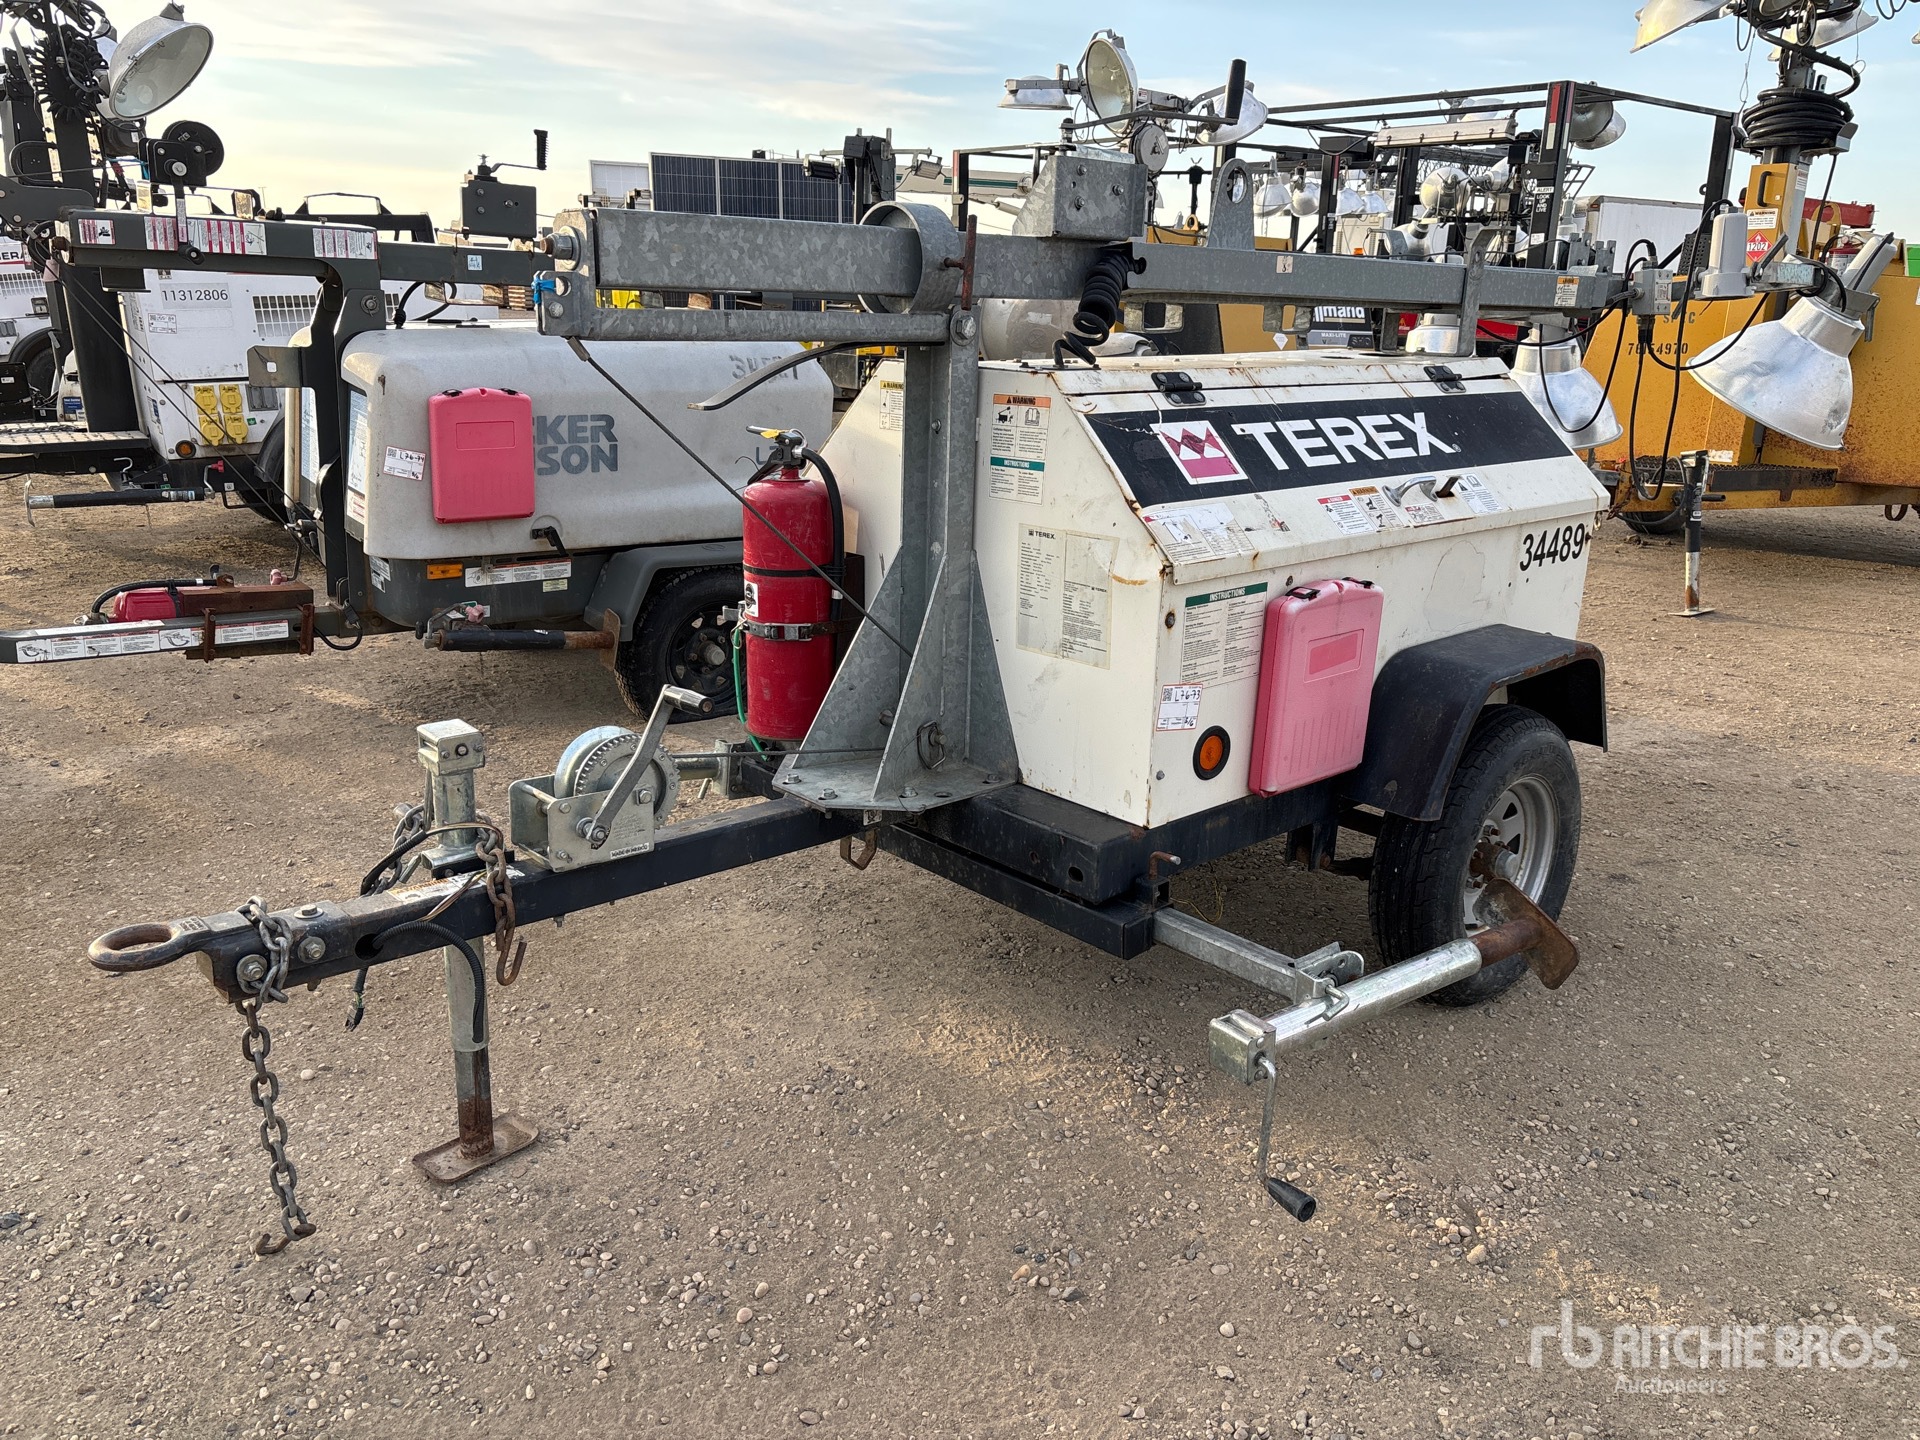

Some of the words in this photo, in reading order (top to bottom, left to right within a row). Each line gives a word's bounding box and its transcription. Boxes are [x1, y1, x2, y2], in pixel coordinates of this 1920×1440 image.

[1748, 242, 1767, 251] 1202
[161, 289, 229, 301] 11312806
[1663, 312, 1696, 324] SC
[1012, 396, 1036, 405] WARNING
[532, 414, 619, 445] KER
[1230, 411, 1458, 471] TEREX
[533, 444, 619, 476] SON
[1034, 530, 1056, 540] TEREX
[1519, 523, 1586, 572] 34489
[1209, 587, 1246, 602] INSTRUCTIONS
